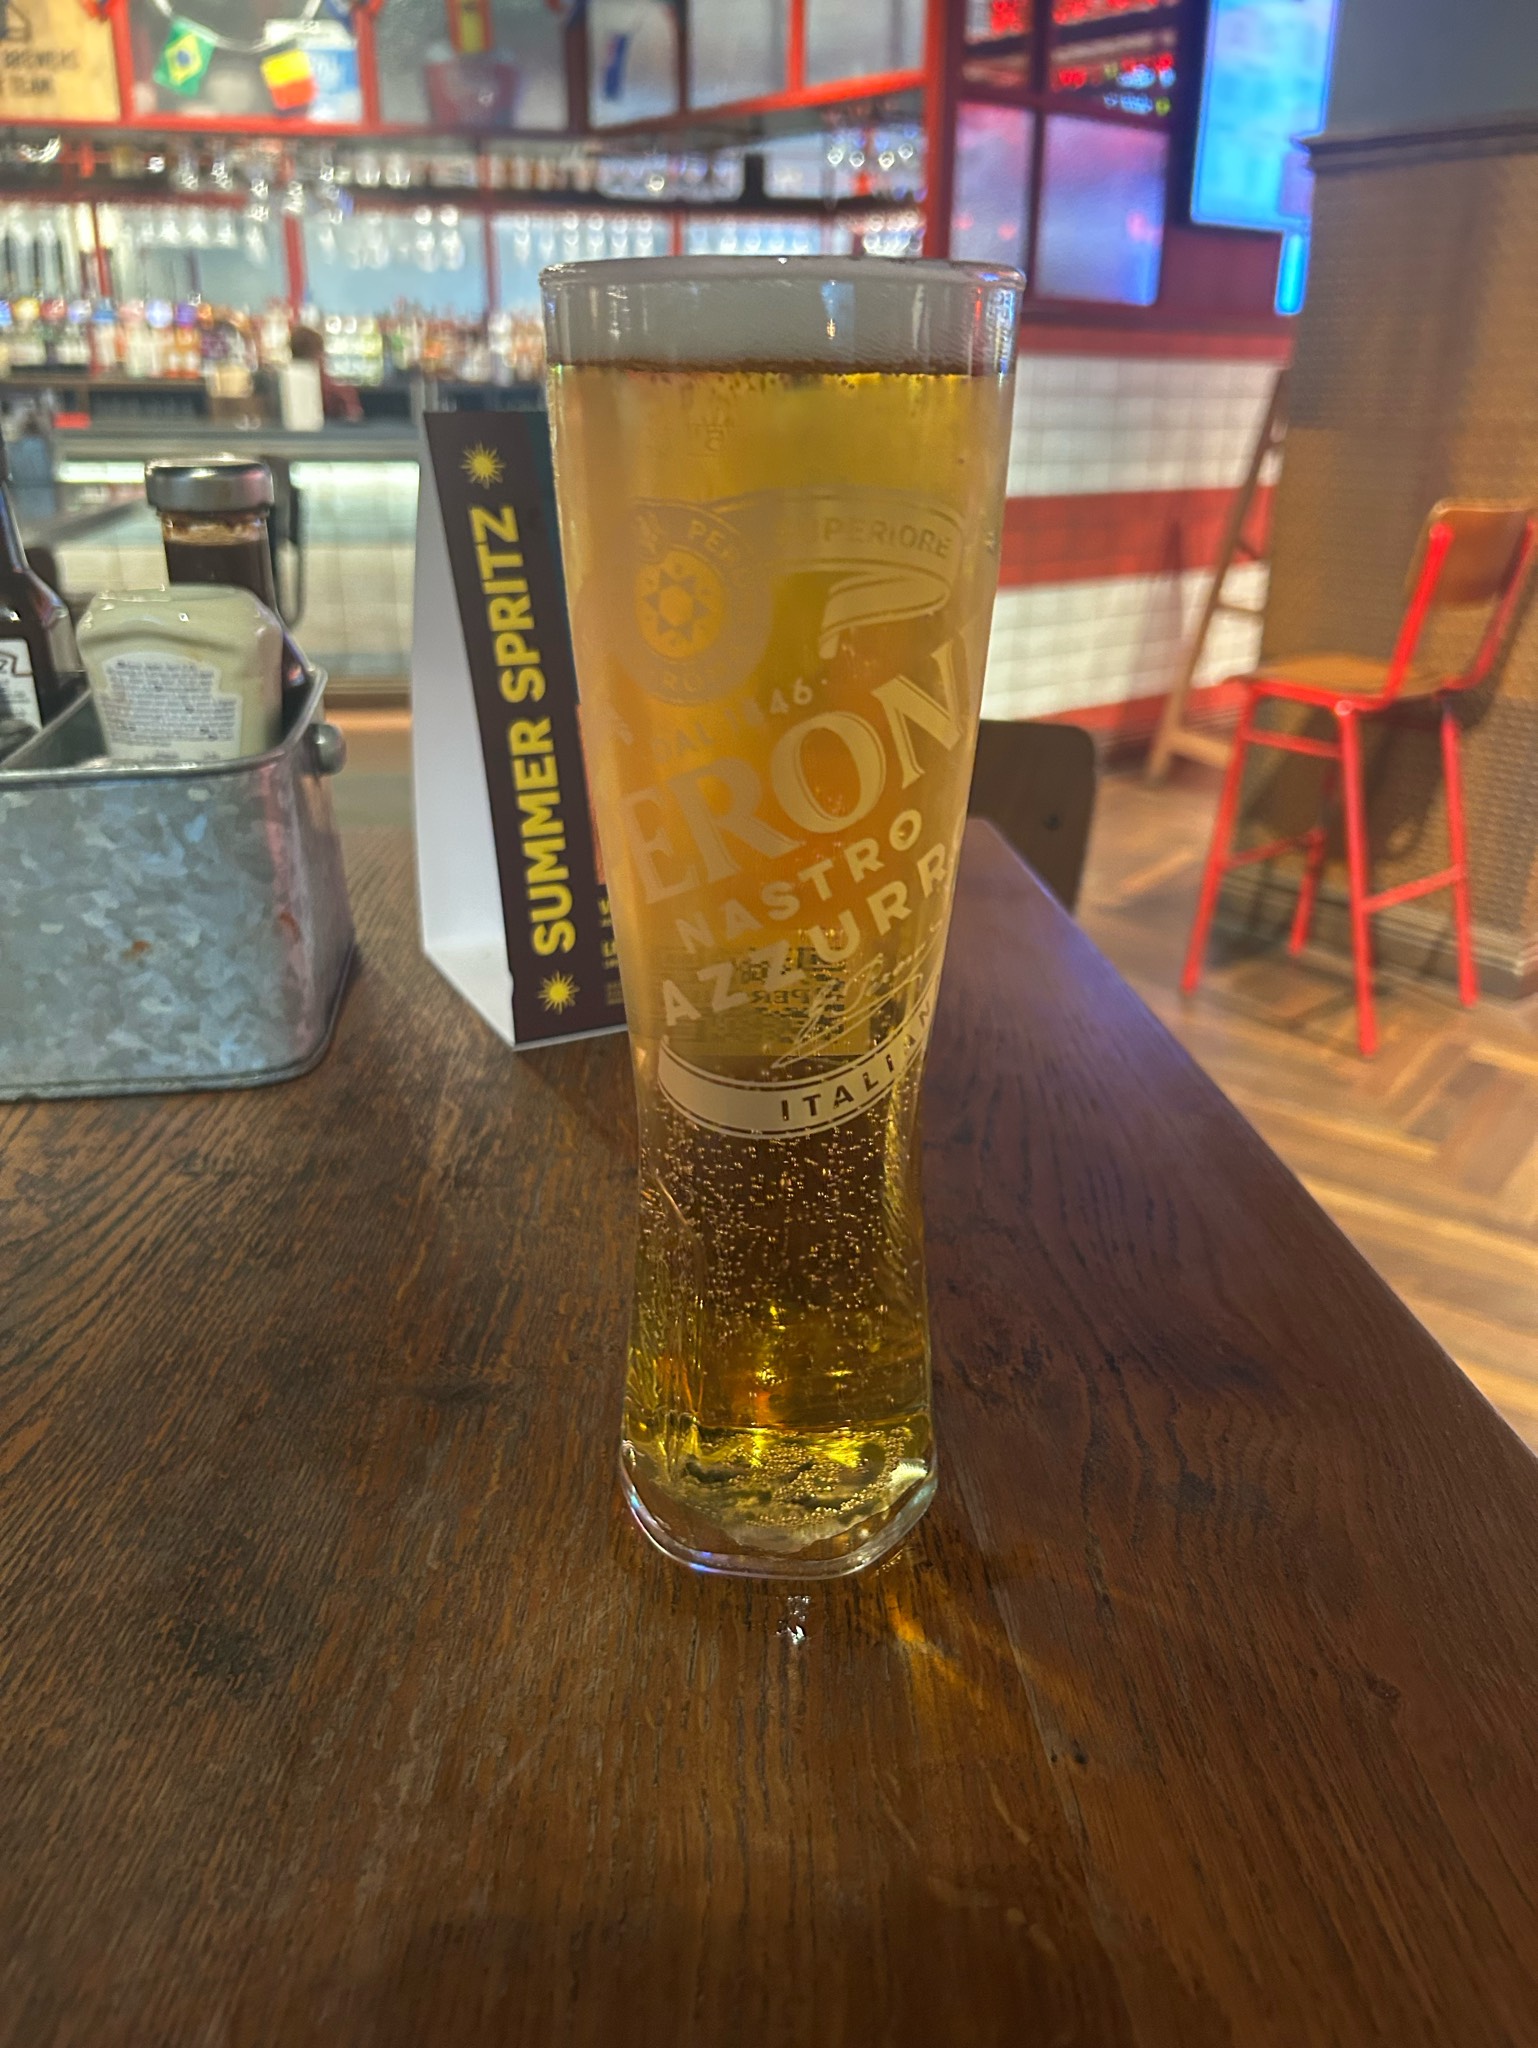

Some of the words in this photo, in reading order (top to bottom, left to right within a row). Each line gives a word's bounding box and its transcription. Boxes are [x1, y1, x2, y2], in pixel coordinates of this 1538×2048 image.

[469, 503, 547, 704] SPRITZ
[776, 516, 953, 560] PERIORE
[510, 714, 576, 957] SUMMER
[612, 620, 982, 906] ERON
[661, 825, 958, 1027] AZZURR
[674, 808, 922, 954] NASTRO
